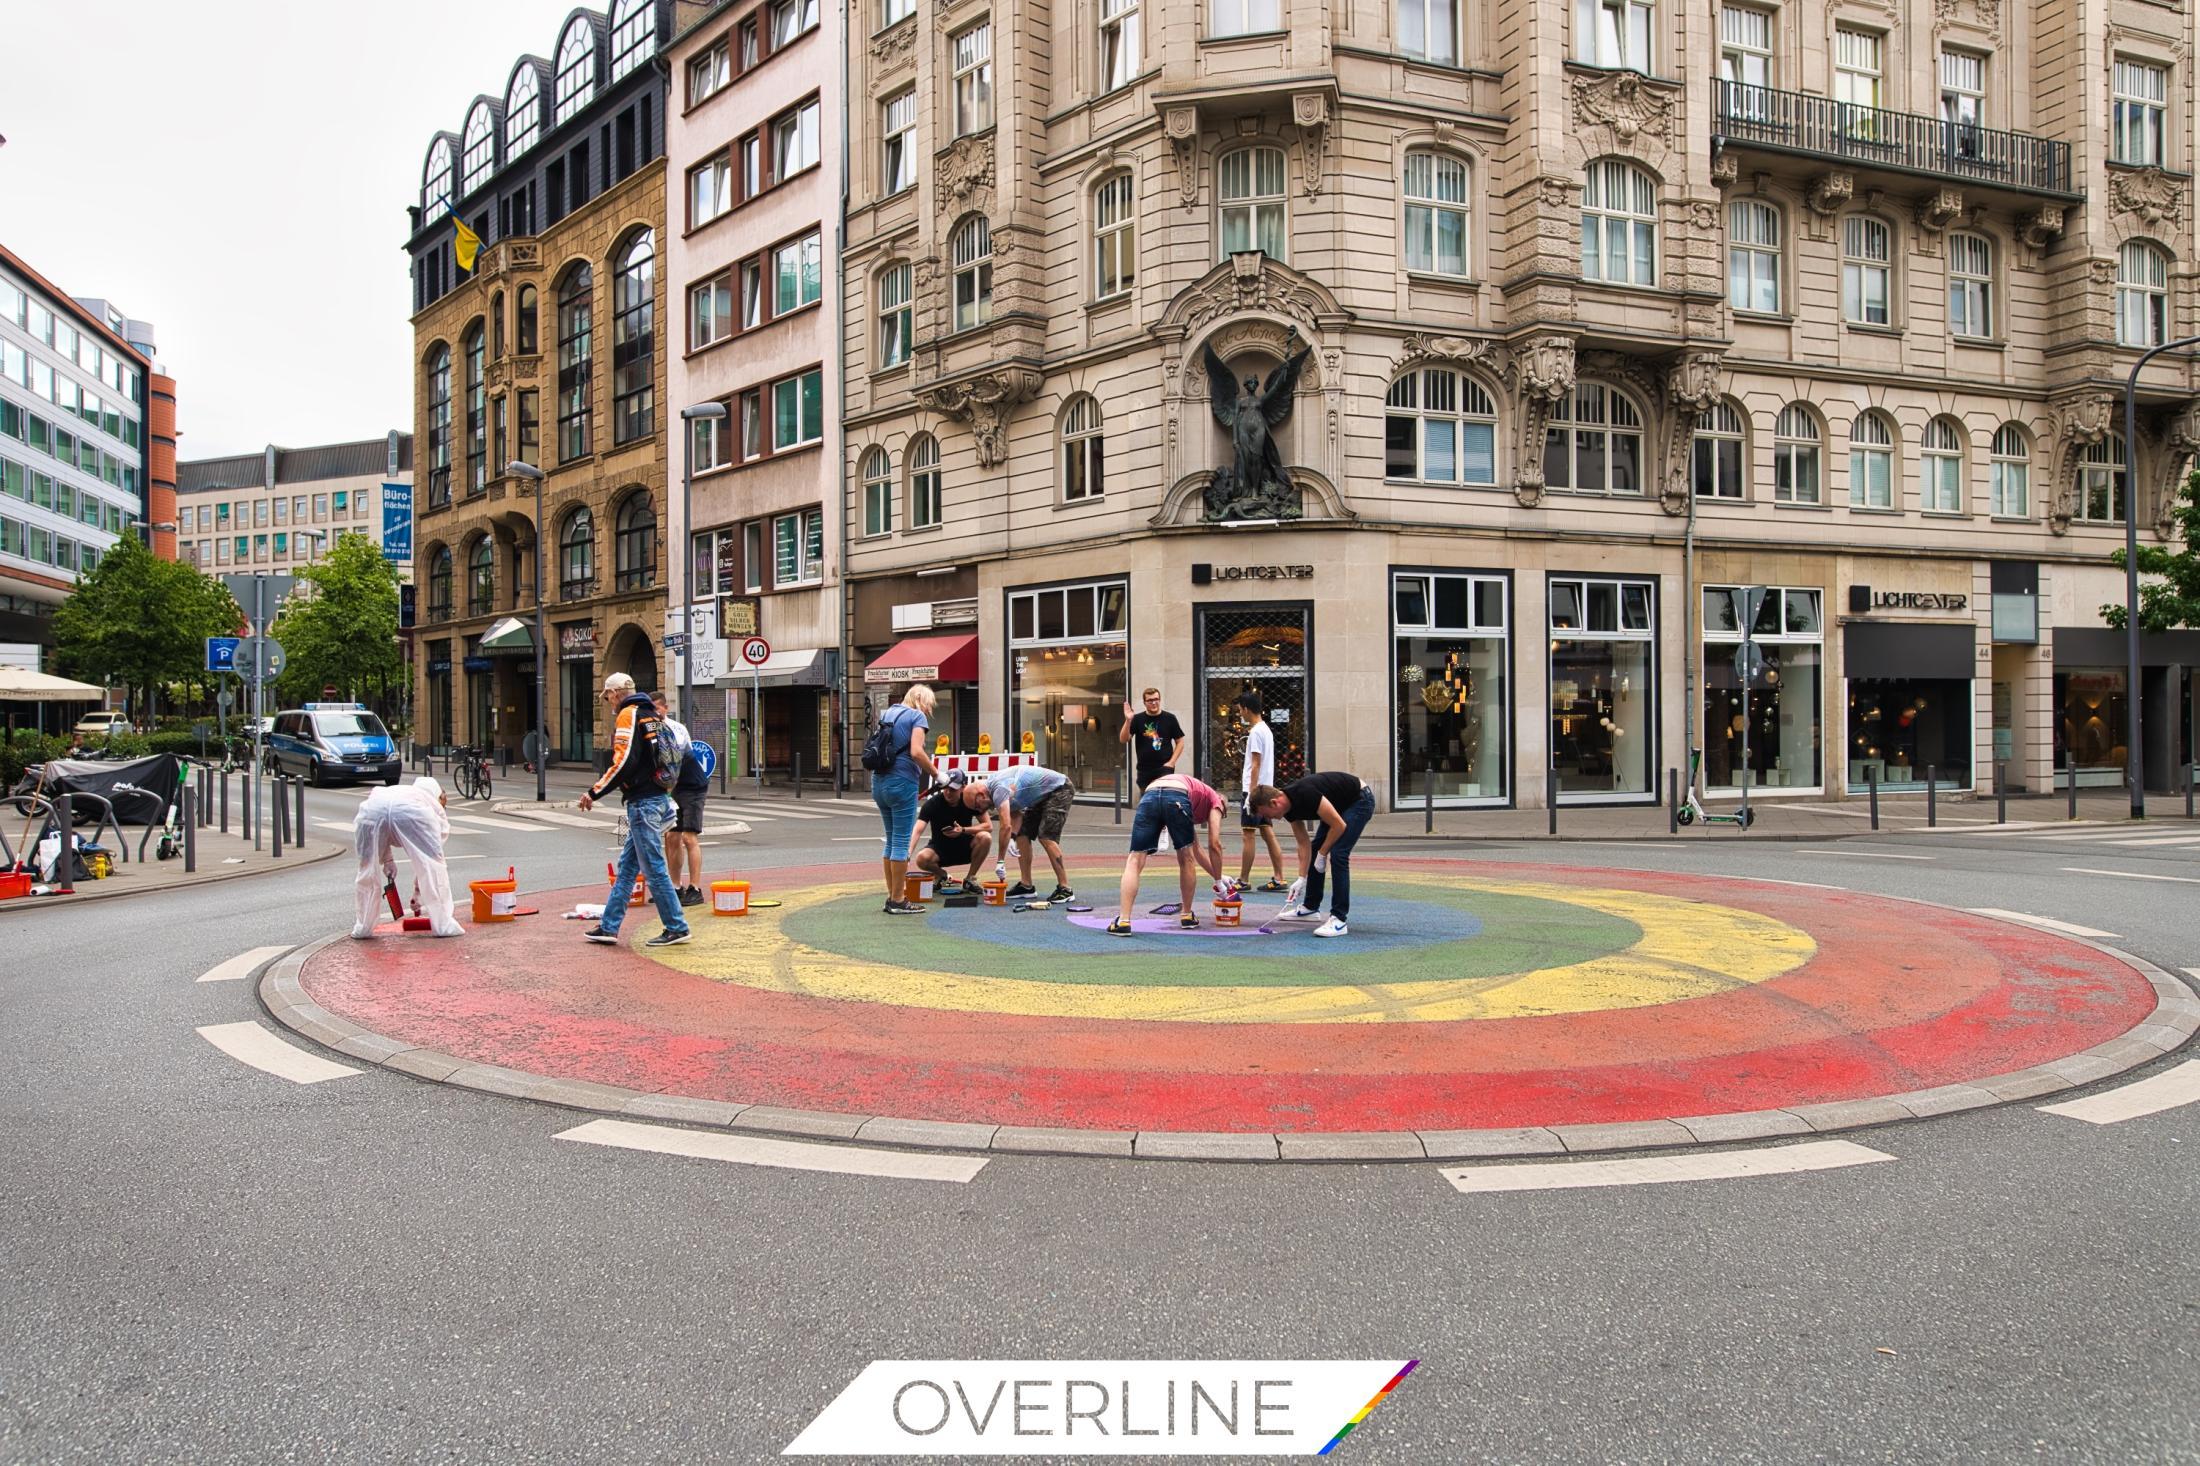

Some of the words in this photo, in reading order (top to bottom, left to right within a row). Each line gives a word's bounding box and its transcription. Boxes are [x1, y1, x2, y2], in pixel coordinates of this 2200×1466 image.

[384, 489, 411, 500] Büro-
[384, 501, 411, 510] flächen
[1874, 592, 1967, 609] LICHTCENTER
[220, 650, 229, 660] P
[748, 644, 765, 658] 40
[1979, 648, 1989, 657] 44
[891, 670, 909, 679] KIOSK
